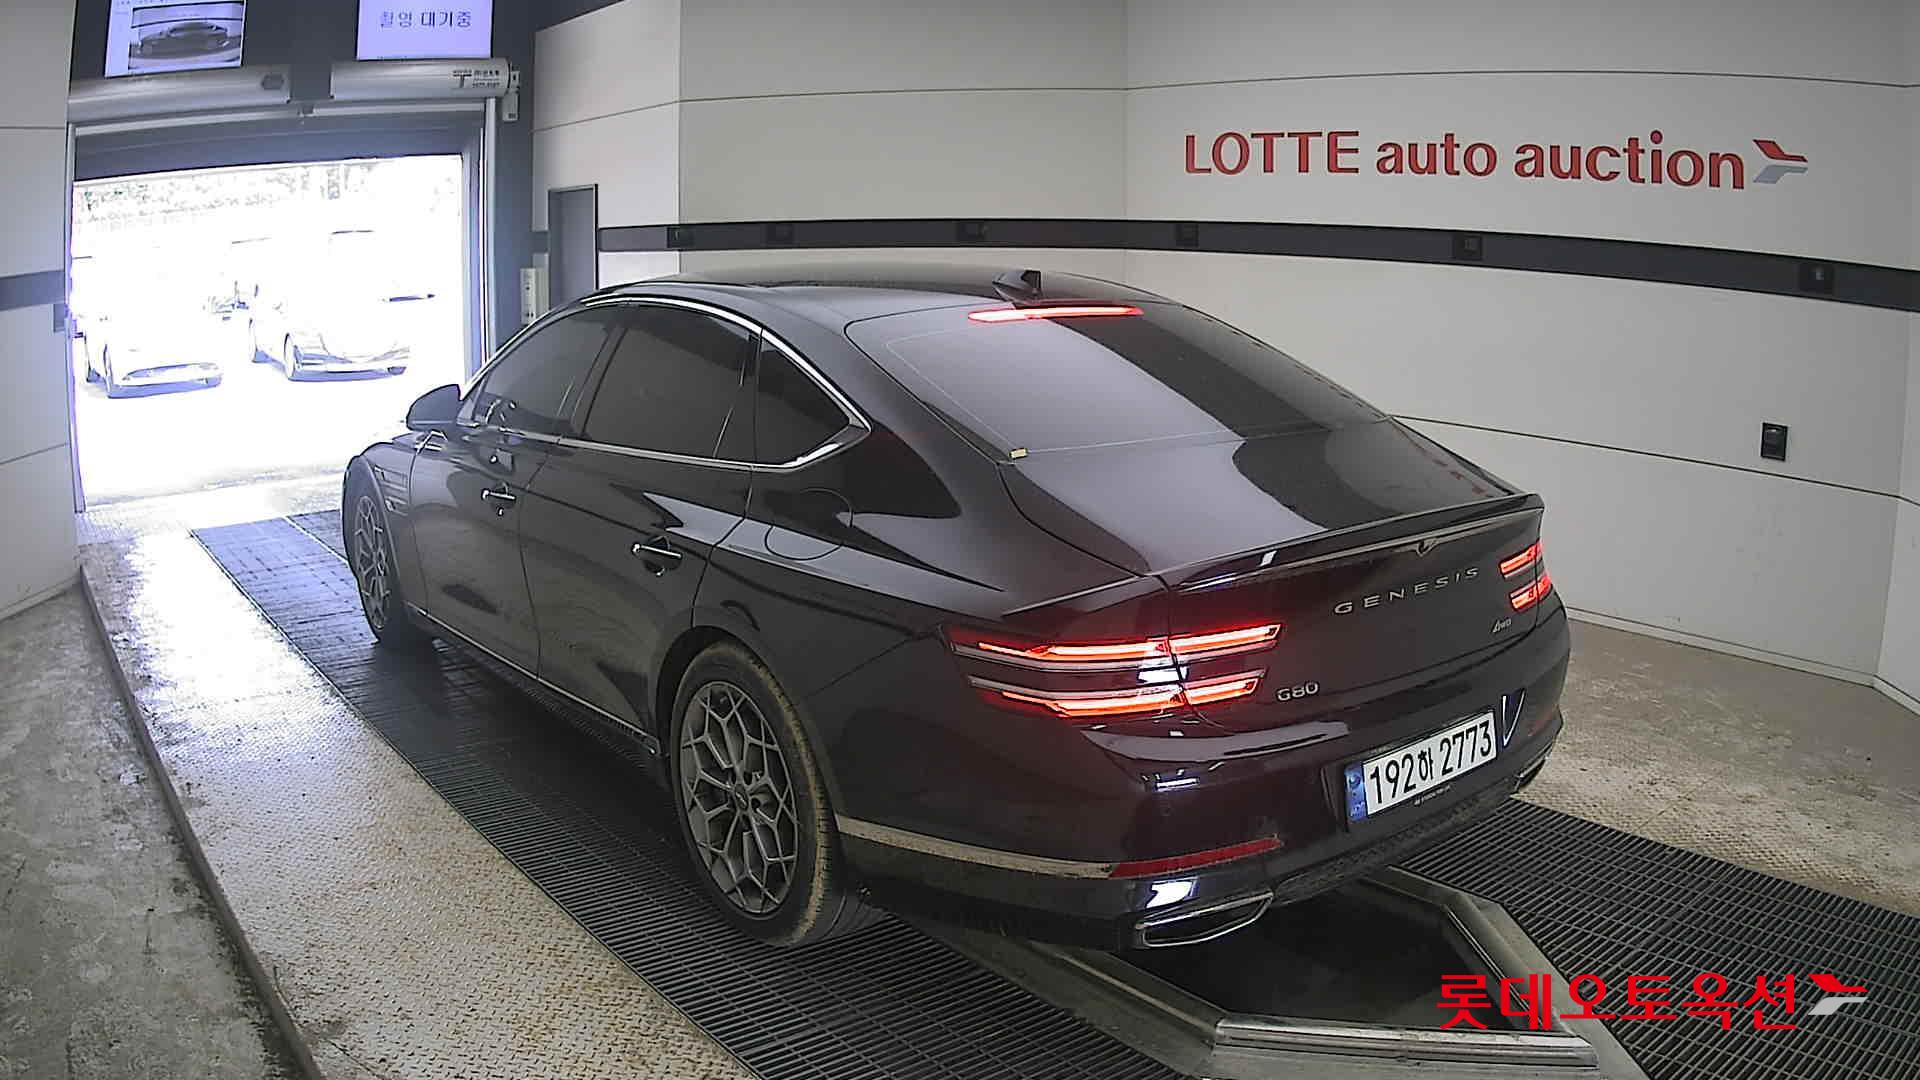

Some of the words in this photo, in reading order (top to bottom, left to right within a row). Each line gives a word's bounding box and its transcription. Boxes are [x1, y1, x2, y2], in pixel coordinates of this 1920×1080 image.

[420, 10, 471, 28] 대기중
[1185, 130, 1360, 175] LOTTE
[1376, 132, 1498, 177] auto
[1514, 130, 1745, 189] auction
[1333, 567, 1479, 615] GENESIS
[1277, 682, 1319, 701] G80
[1370, 747, 1434, 804] 192하
[1440, 719, 1493, 777] 2773
